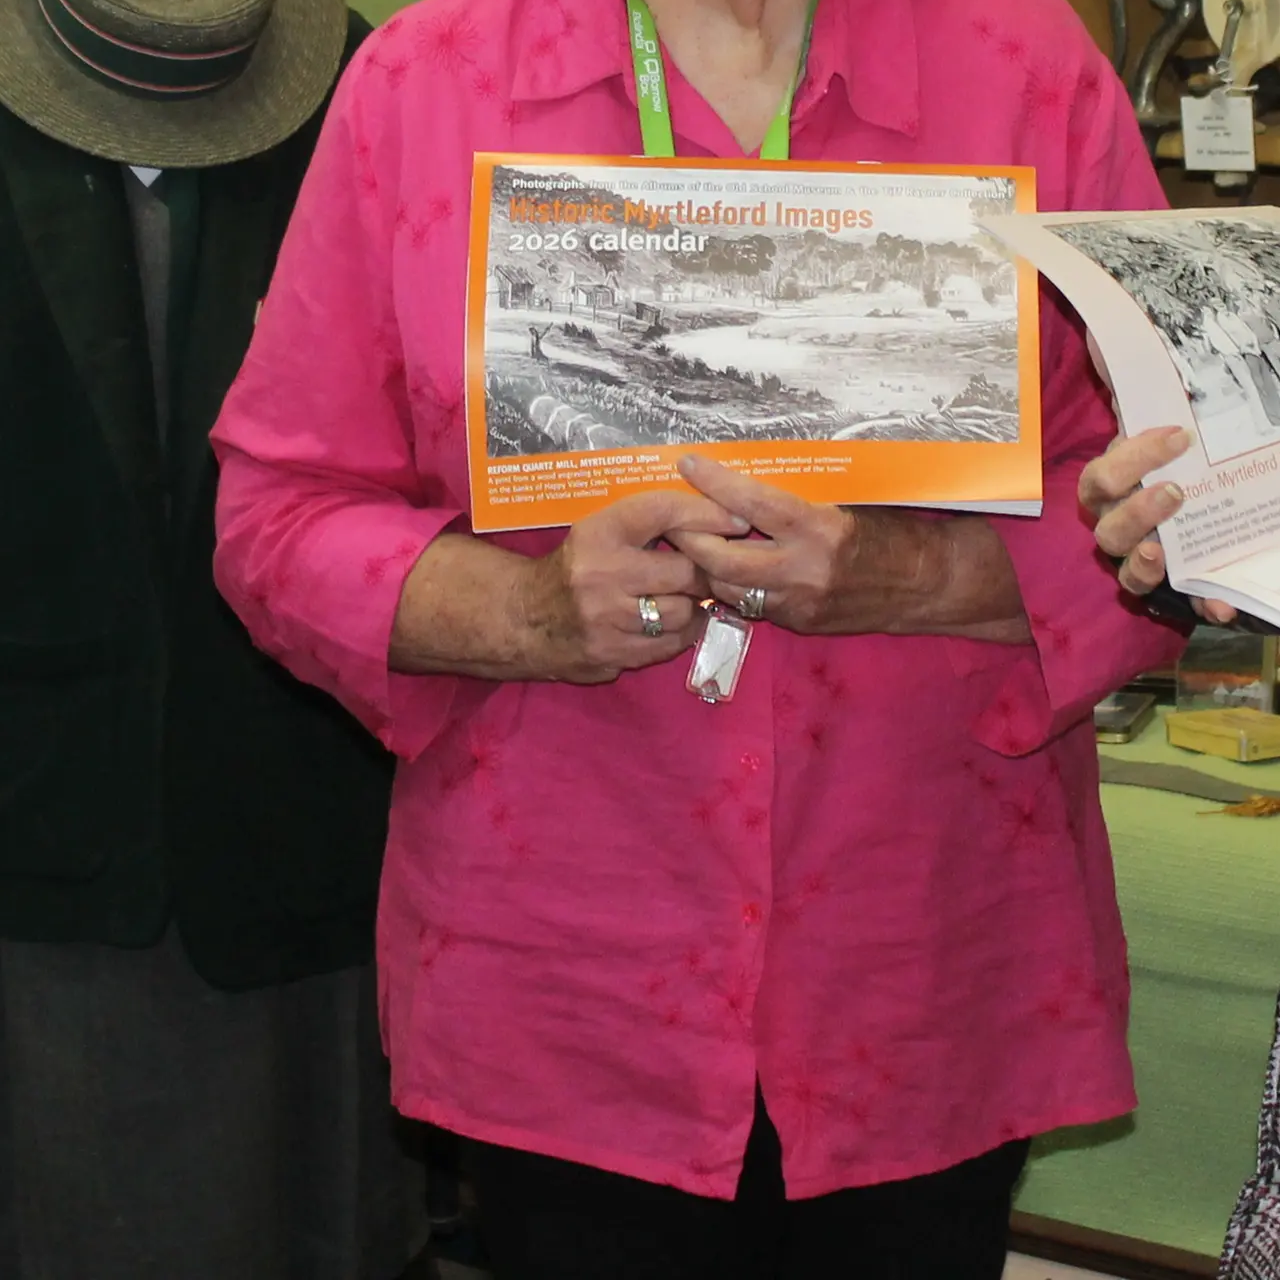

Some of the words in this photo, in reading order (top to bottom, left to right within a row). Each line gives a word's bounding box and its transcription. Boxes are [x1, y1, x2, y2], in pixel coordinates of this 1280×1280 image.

[639, 74, 650, 98] Box
[512, 178, 585, 192] Photographs
[509, 196, 616, 224] Historic
[624, 197, 767, 230] Myrtleford
[775, 201, 873, 234] Images
[508, 229, 578, 252] 2026
[589, 229, 709, 252] calendar
[488, 464, 525, 475] REFORM
[522, 462, 553, 473] QUARTZ
[556, 459, 578, 469] MILL,
[580, 456, 633, 468] MYRTLEFORD
[1182, 480, 1214, 501] storic
[1217, 453, 1278, 490] Myrtleford
